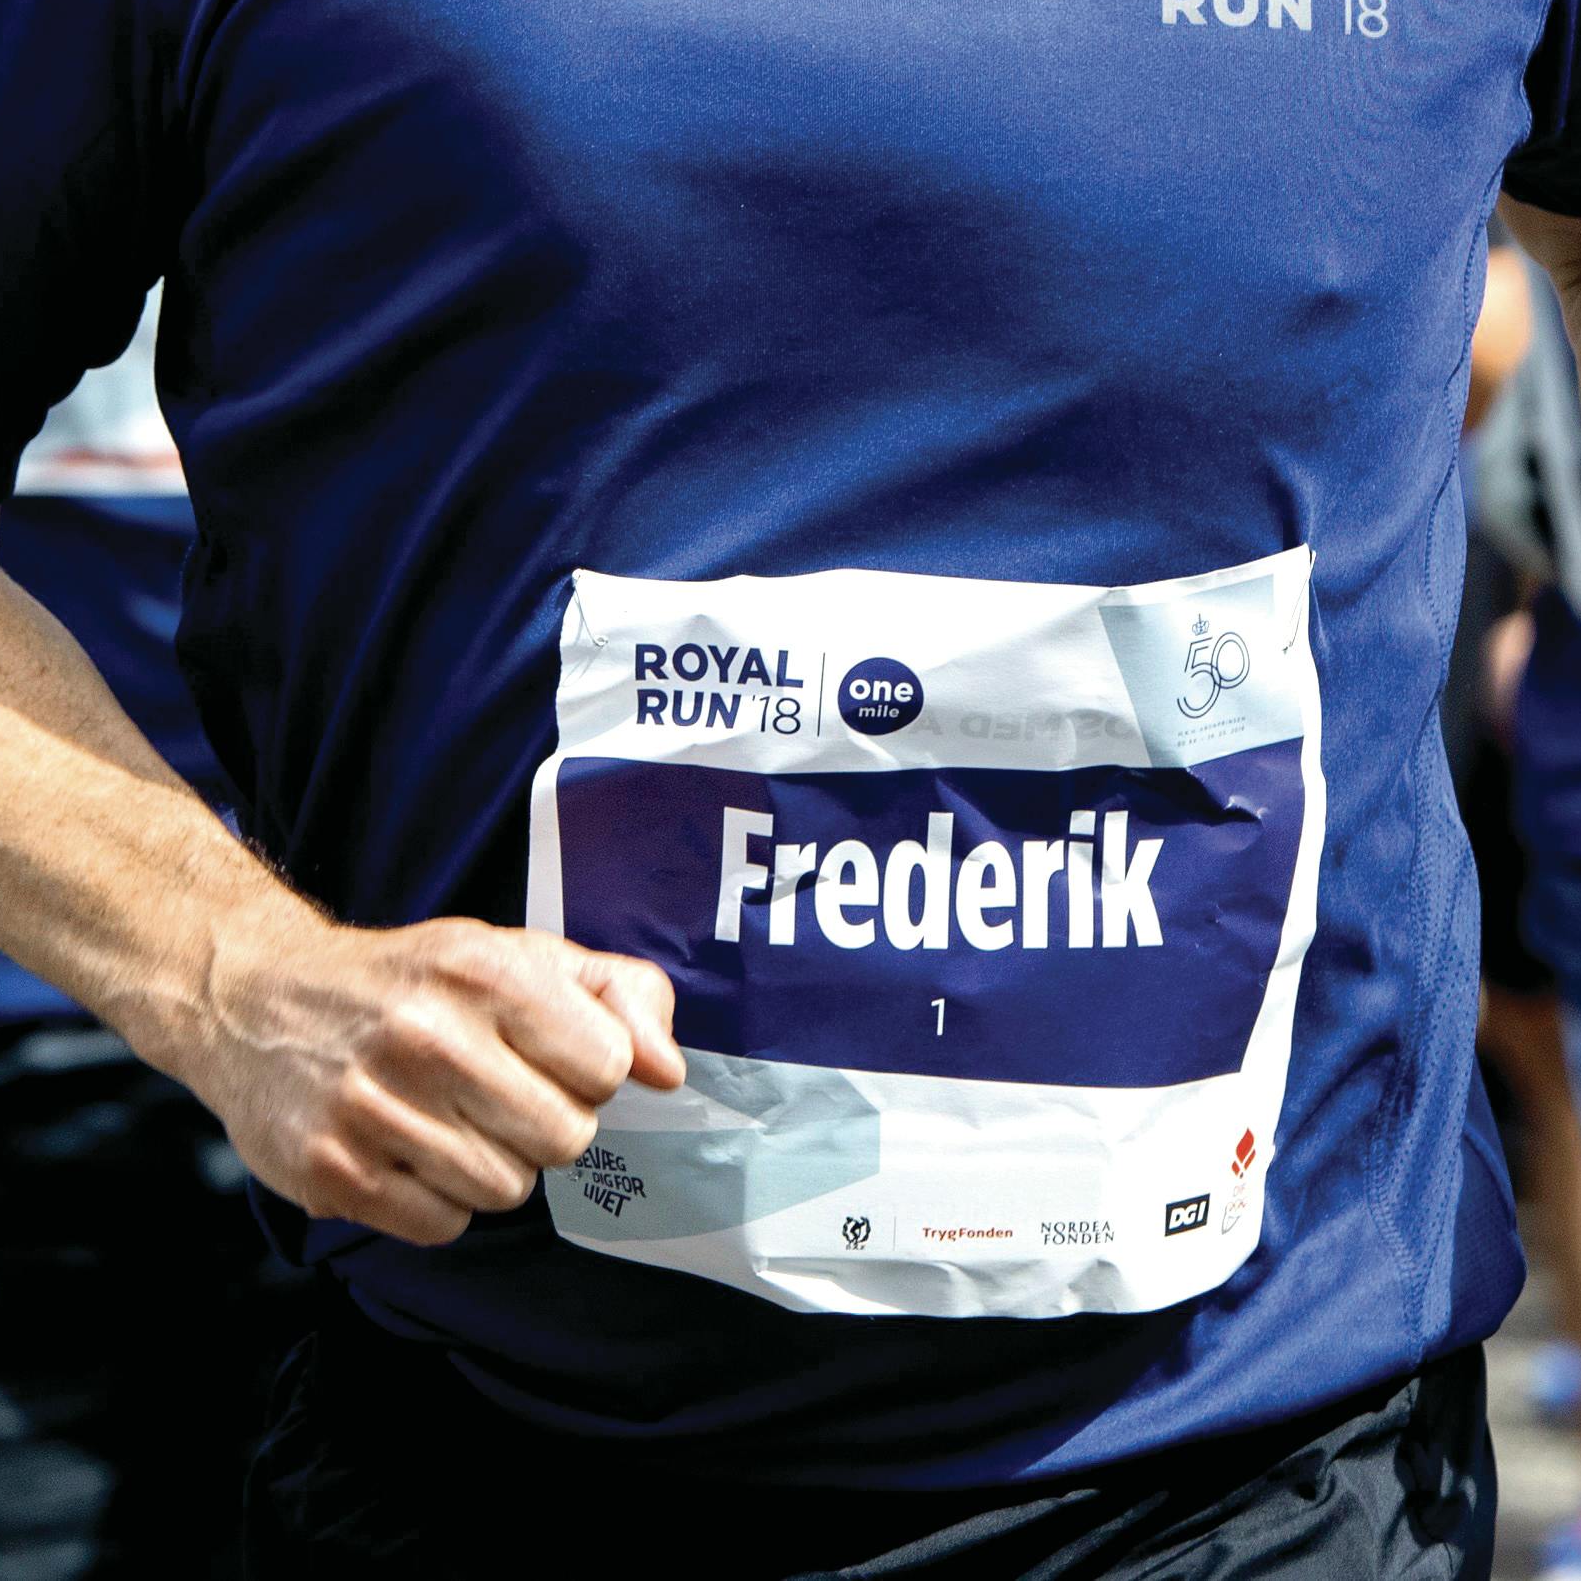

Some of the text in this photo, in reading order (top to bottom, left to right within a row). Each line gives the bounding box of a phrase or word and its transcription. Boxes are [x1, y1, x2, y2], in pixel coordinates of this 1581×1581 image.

[634, 643, 804, 688] ROYAL
[1177, 631, 1250, 719] 50
[849, 678, 914, 703] one
[636, 689, 801, 735] RUN '18
[858, 705, 900, 718] mile
[714, 806, 1165, 951] Frederik
[930, 998, 946, 1036] 1
[584, 1182, 631, 1217] LIVET
[592, 1172, 647, 1198] DIG FOR
[1040, 1220, 1111, 1235] NORDEA
[1168, 1200, 1207, 1230] DGI
[922, 1227, 1014, 1242] TrygFonden
[1043, 1230, 1115, 1245] FONDEN
